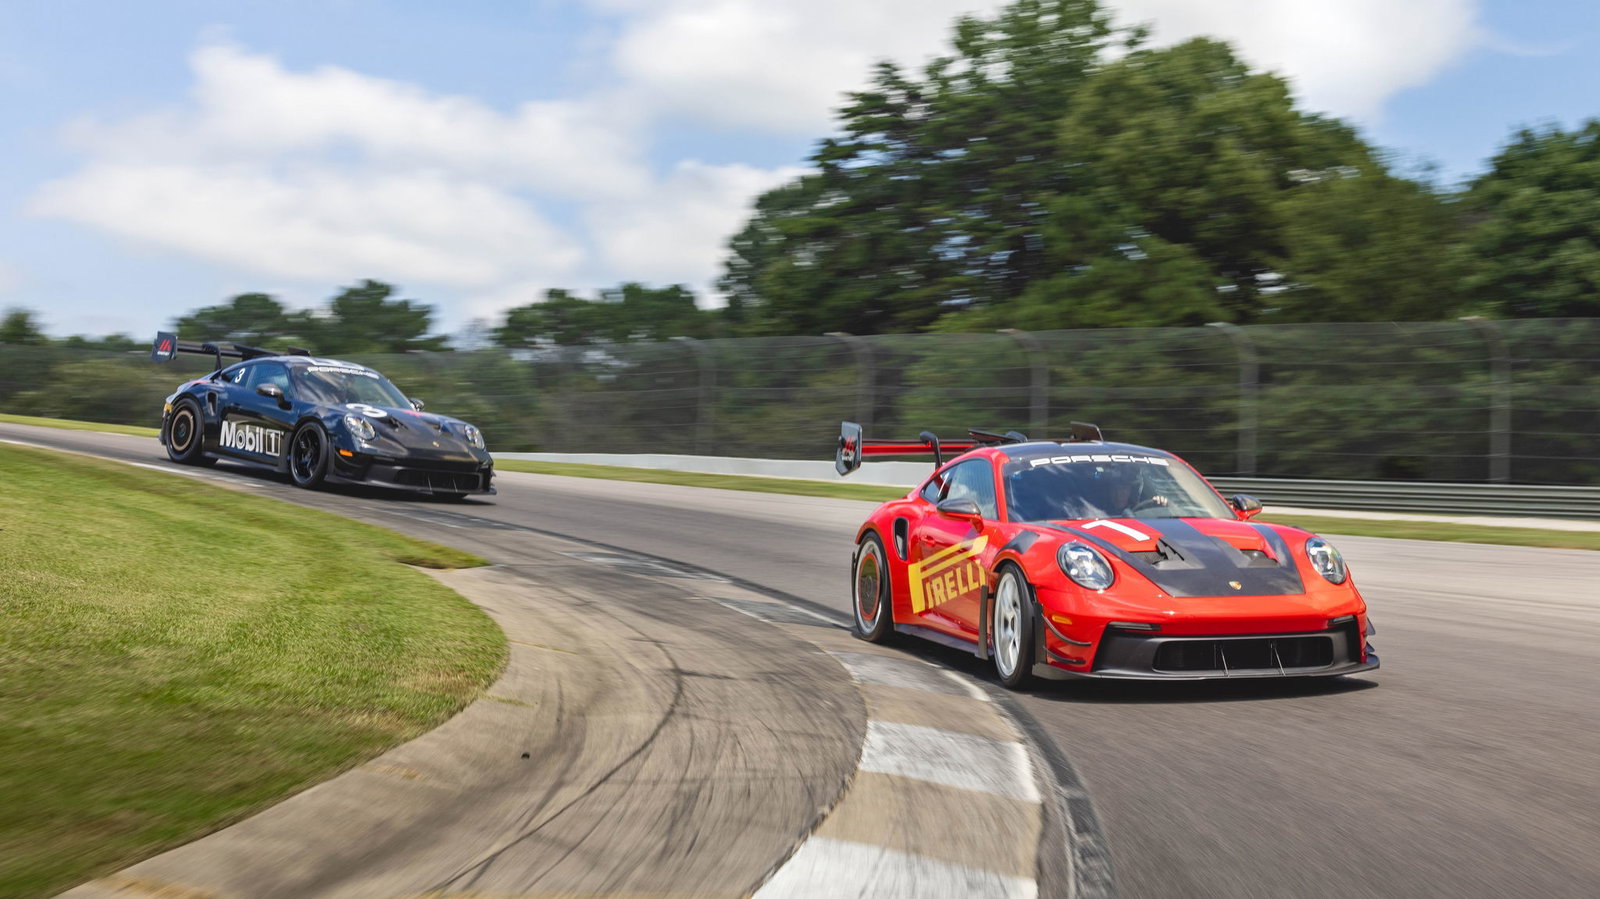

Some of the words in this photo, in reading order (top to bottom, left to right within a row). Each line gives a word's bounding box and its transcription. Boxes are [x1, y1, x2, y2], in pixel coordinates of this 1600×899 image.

[234, 368, 246, 383] 3
[346, 403, 388, 418] 3
[219, 420, 264, 454] Mobil
[1030, 454, 1169, 468] PORSCHE
[1081, 520, 1151, 542] 1
[908, 535, 988, 614] PIRELLI
